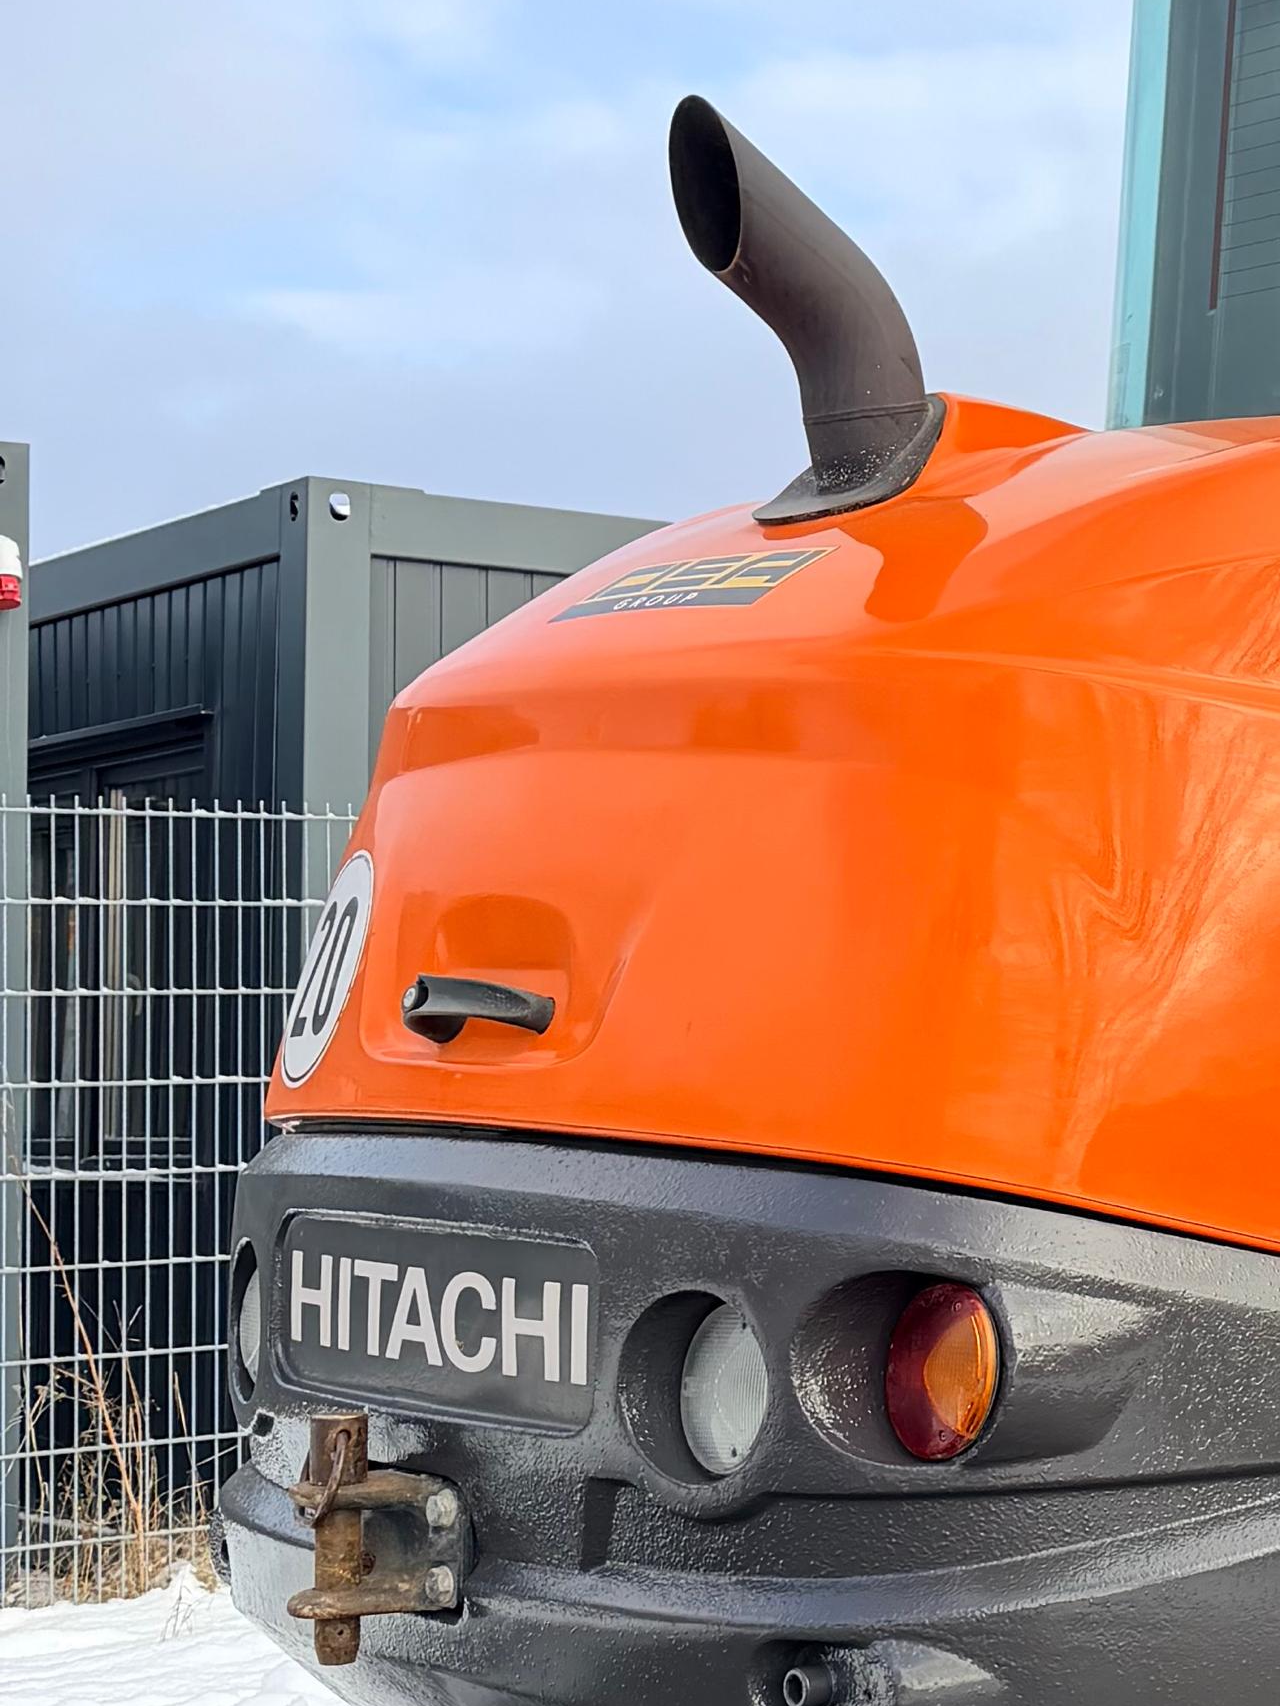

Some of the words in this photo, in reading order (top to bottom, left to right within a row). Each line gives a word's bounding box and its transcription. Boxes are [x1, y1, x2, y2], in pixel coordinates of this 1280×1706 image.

[612, 591, 701, 611] GROUP
[289, 894, 361, 1040] 20
[289, 1248, 590, 1386] HITACHI
